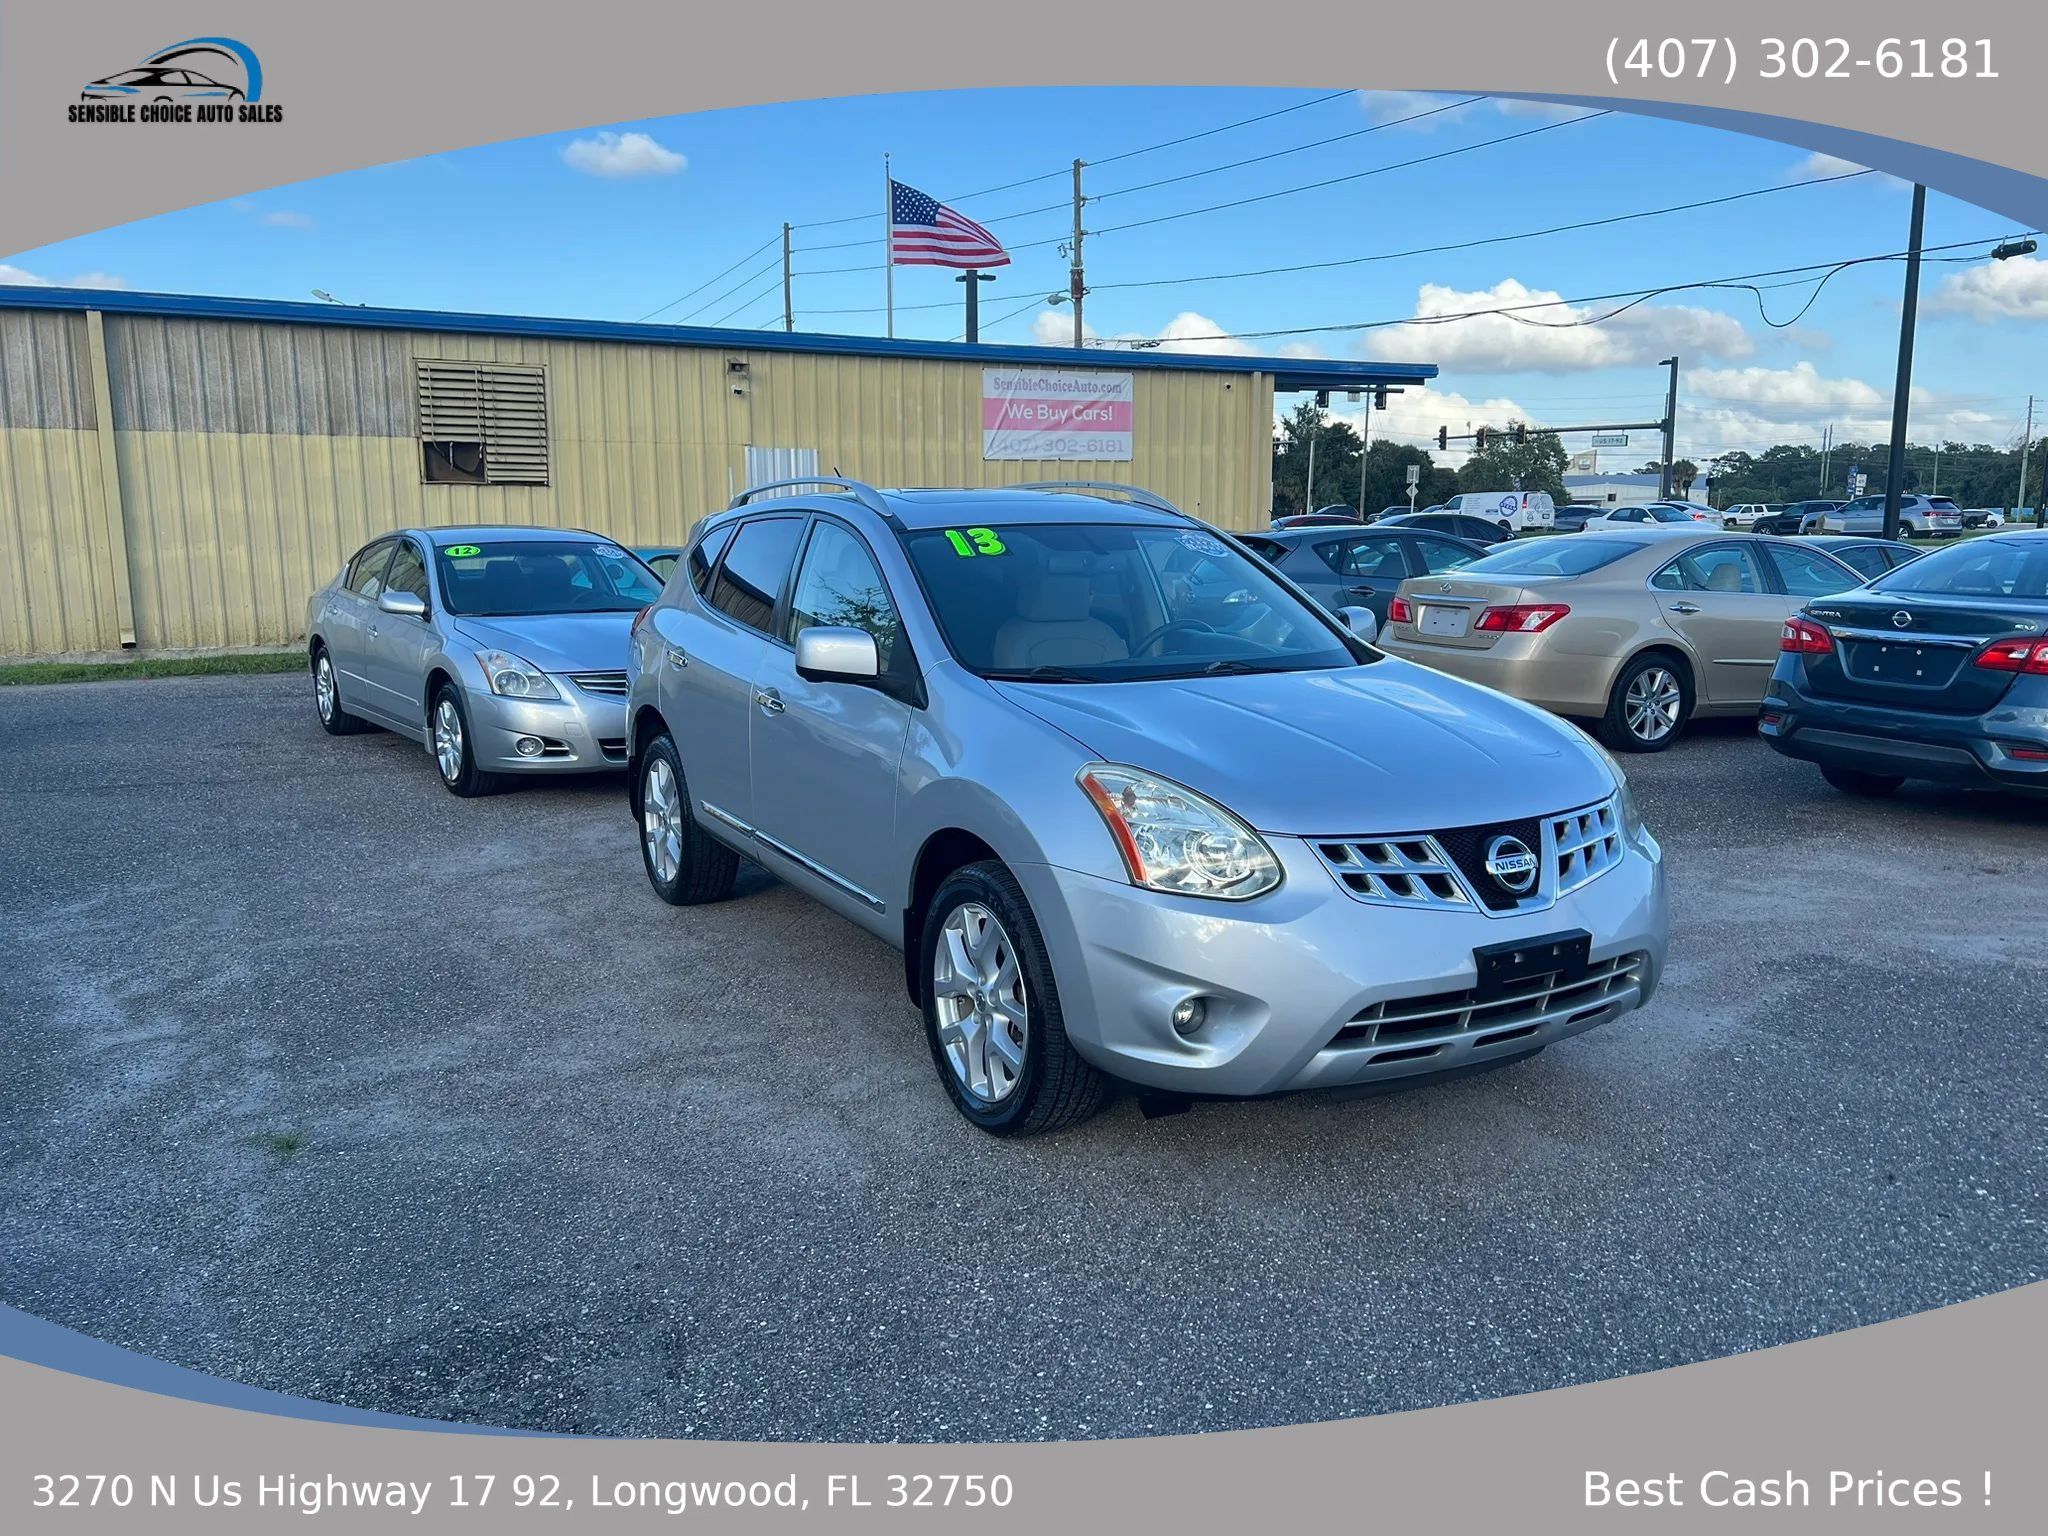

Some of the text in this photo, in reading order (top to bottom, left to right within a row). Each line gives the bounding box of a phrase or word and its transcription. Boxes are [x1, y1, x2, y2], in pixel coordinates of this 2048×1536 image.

[993, 376, 1122, 394] SensibleChoiceAuto.com
[1006, 403, 1113, 424] We Buy Cars!
[1043, 439, 1124, 453] 302-6181
[945, 528, 1006, 557] 13
[454, 547, 472, 555] 12
[1810, 609, 1842, 618] SENTRA
[1495, 858, 1536, 871] NISSAN
